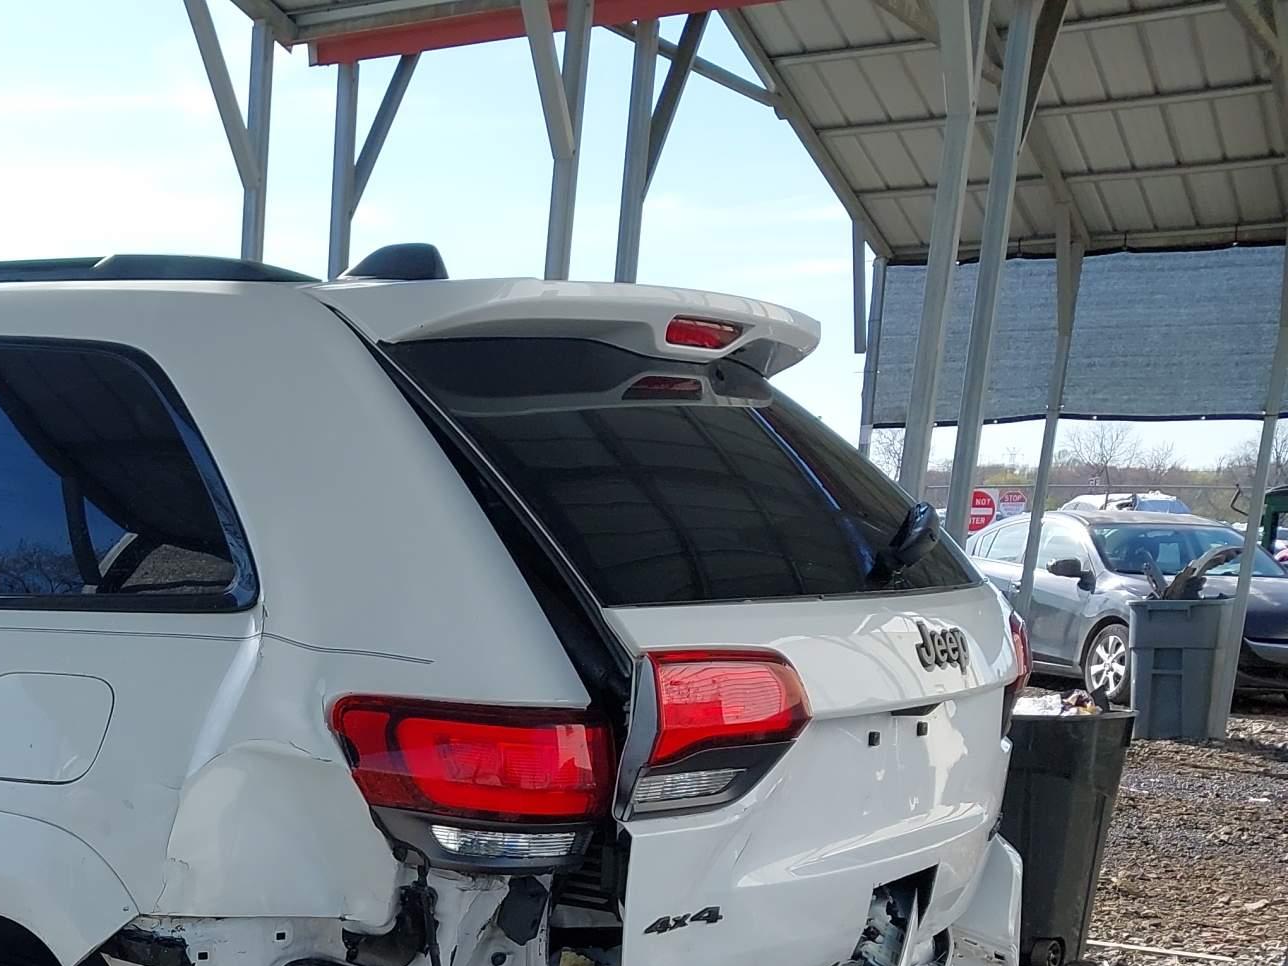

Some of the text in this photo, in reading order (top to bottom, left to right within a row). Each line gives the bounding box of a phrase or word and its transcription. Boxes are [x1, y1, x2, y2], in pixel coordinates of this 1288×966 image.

[975, 498, 991, 506] NOT
[1004, 494, 1022, 502] STOP
[915, 620, 970, 675] Jeep
[643, 906, 723, 935] 4x4
